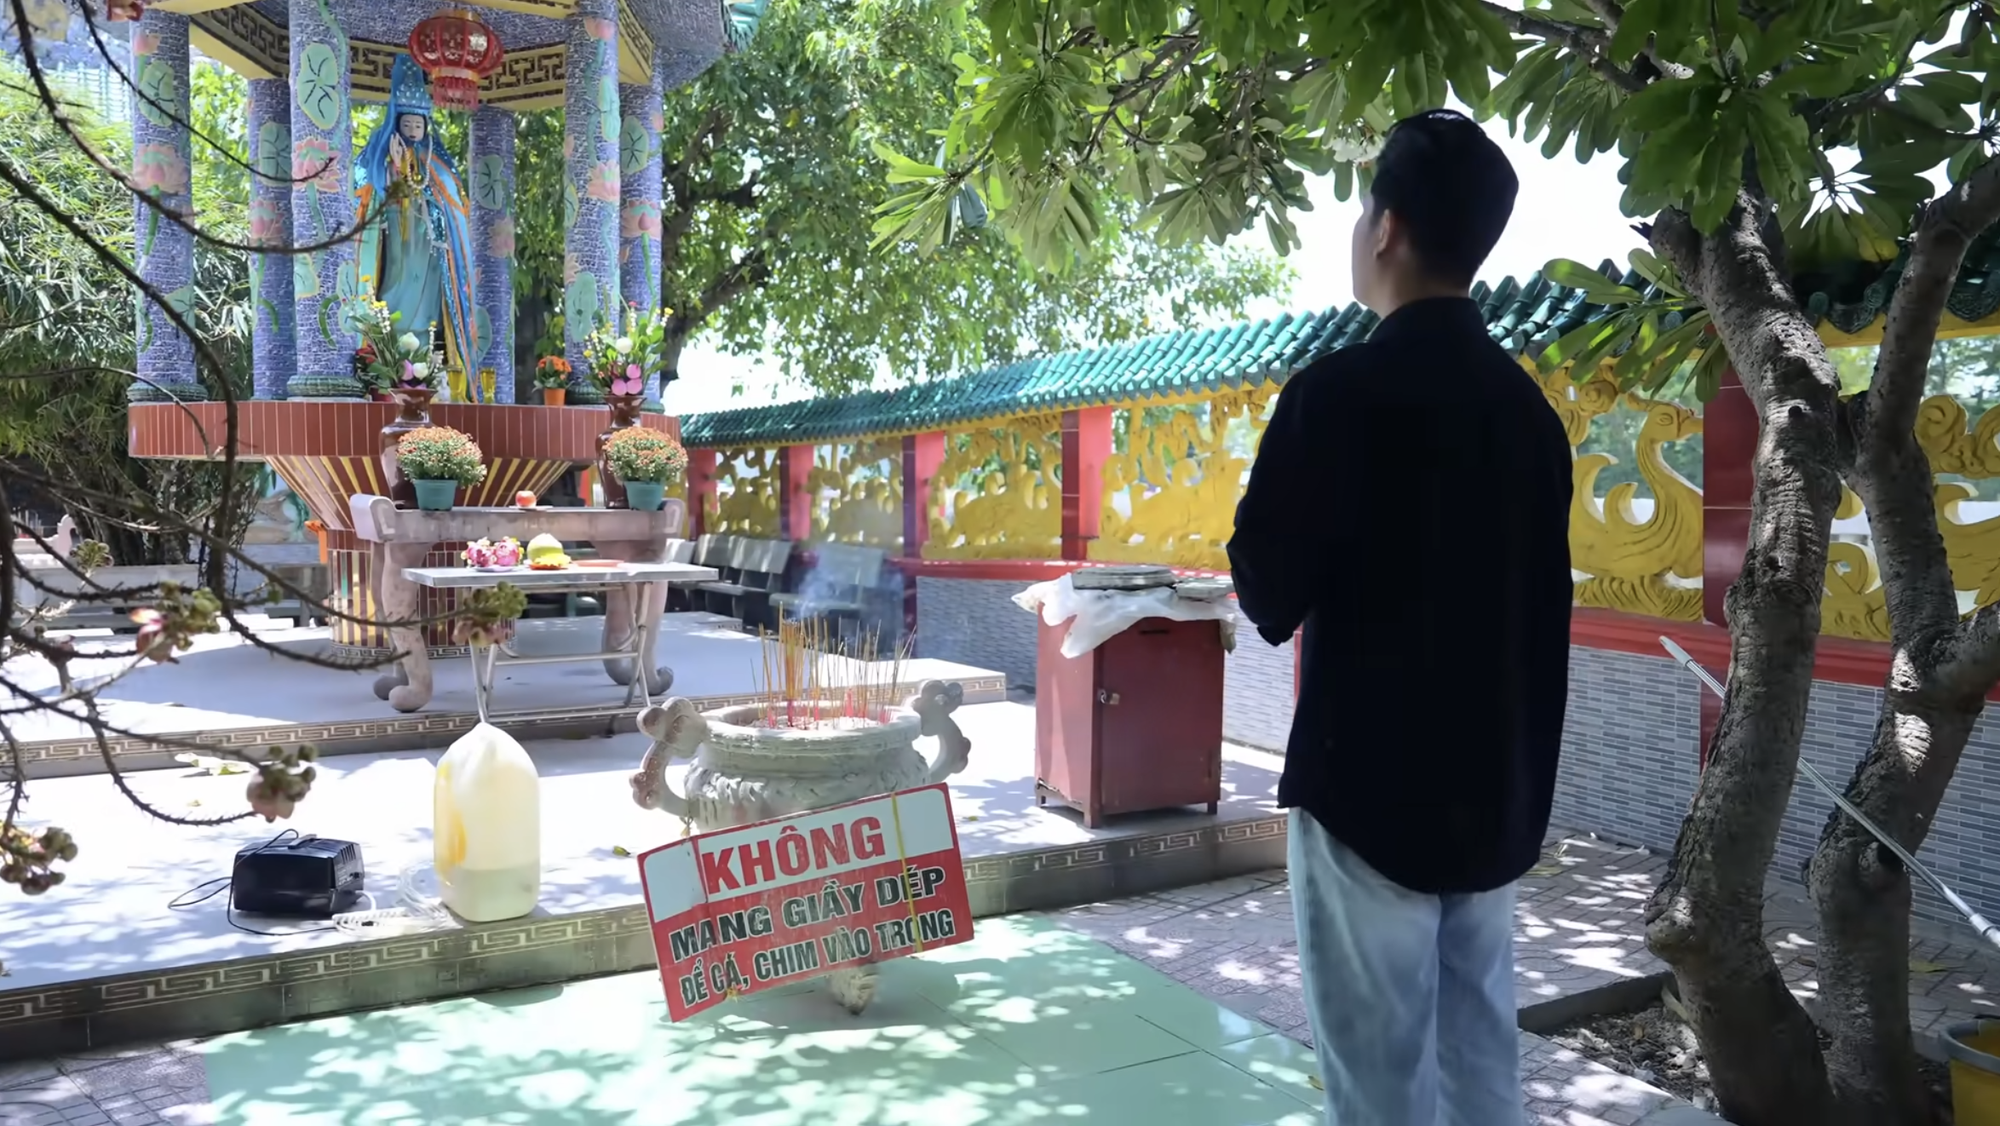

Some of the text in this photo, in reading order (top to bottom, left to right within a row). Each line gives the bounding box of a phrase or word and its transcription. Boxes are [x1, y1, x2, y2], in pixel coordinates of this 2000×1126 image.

[701, 816, 886, 895] KHÔNG
[668, 864, 946, 963] MANG GIẦY DÉP
[678, 956, 710, 1009] ĐỂ
[752, 939, 820, 982] CHIM
[821, 925, 872, 966] VÀO
[873, 907, 956, 952] TRONG
